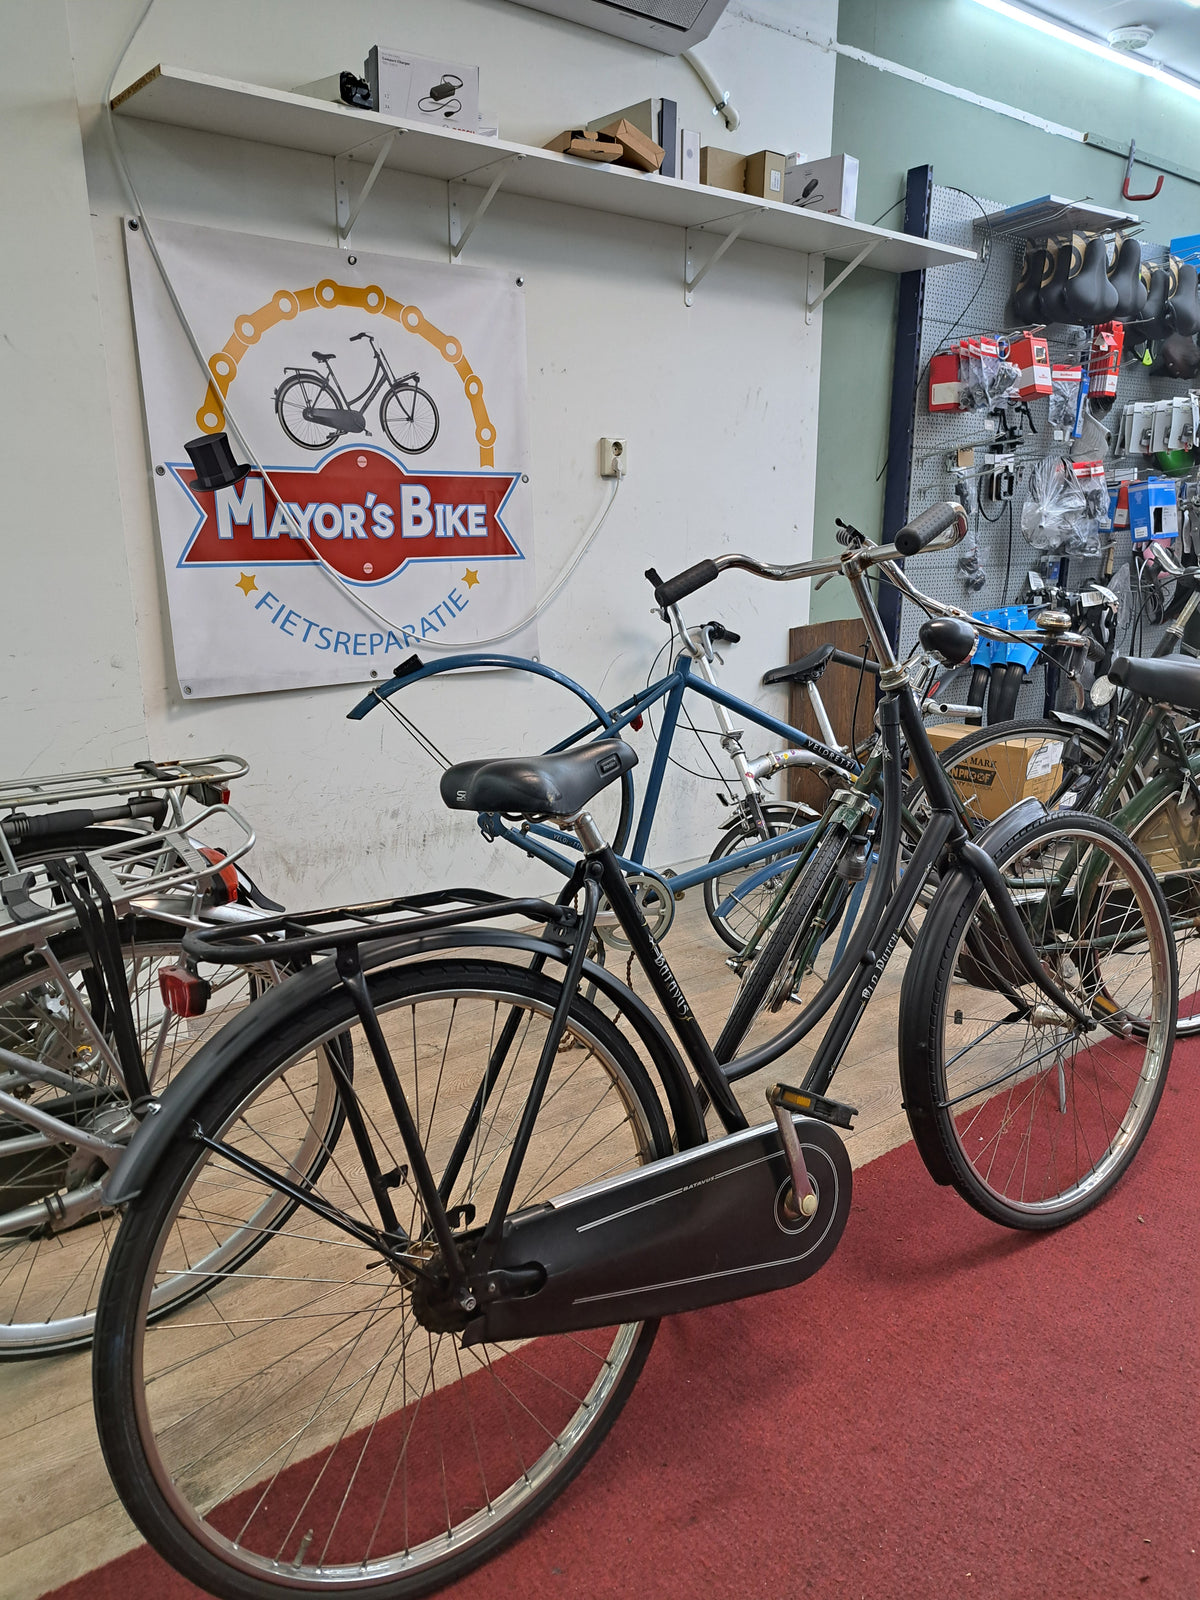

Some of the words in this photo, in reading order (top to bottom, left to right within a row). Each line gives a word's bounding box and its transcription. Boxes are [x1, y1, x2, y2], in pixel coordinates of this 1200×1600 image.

[214, 477, 395, 539] MAYOR'S
[399, 483, 488, 538] BIKE
[254, 587, 470, 656] FIETSREPARATIE
[807, 740, 856, 769] VELORETTI
[970, 757, 997, 768] MARK
[683, 1176, 715, 1191] BATAVUS
